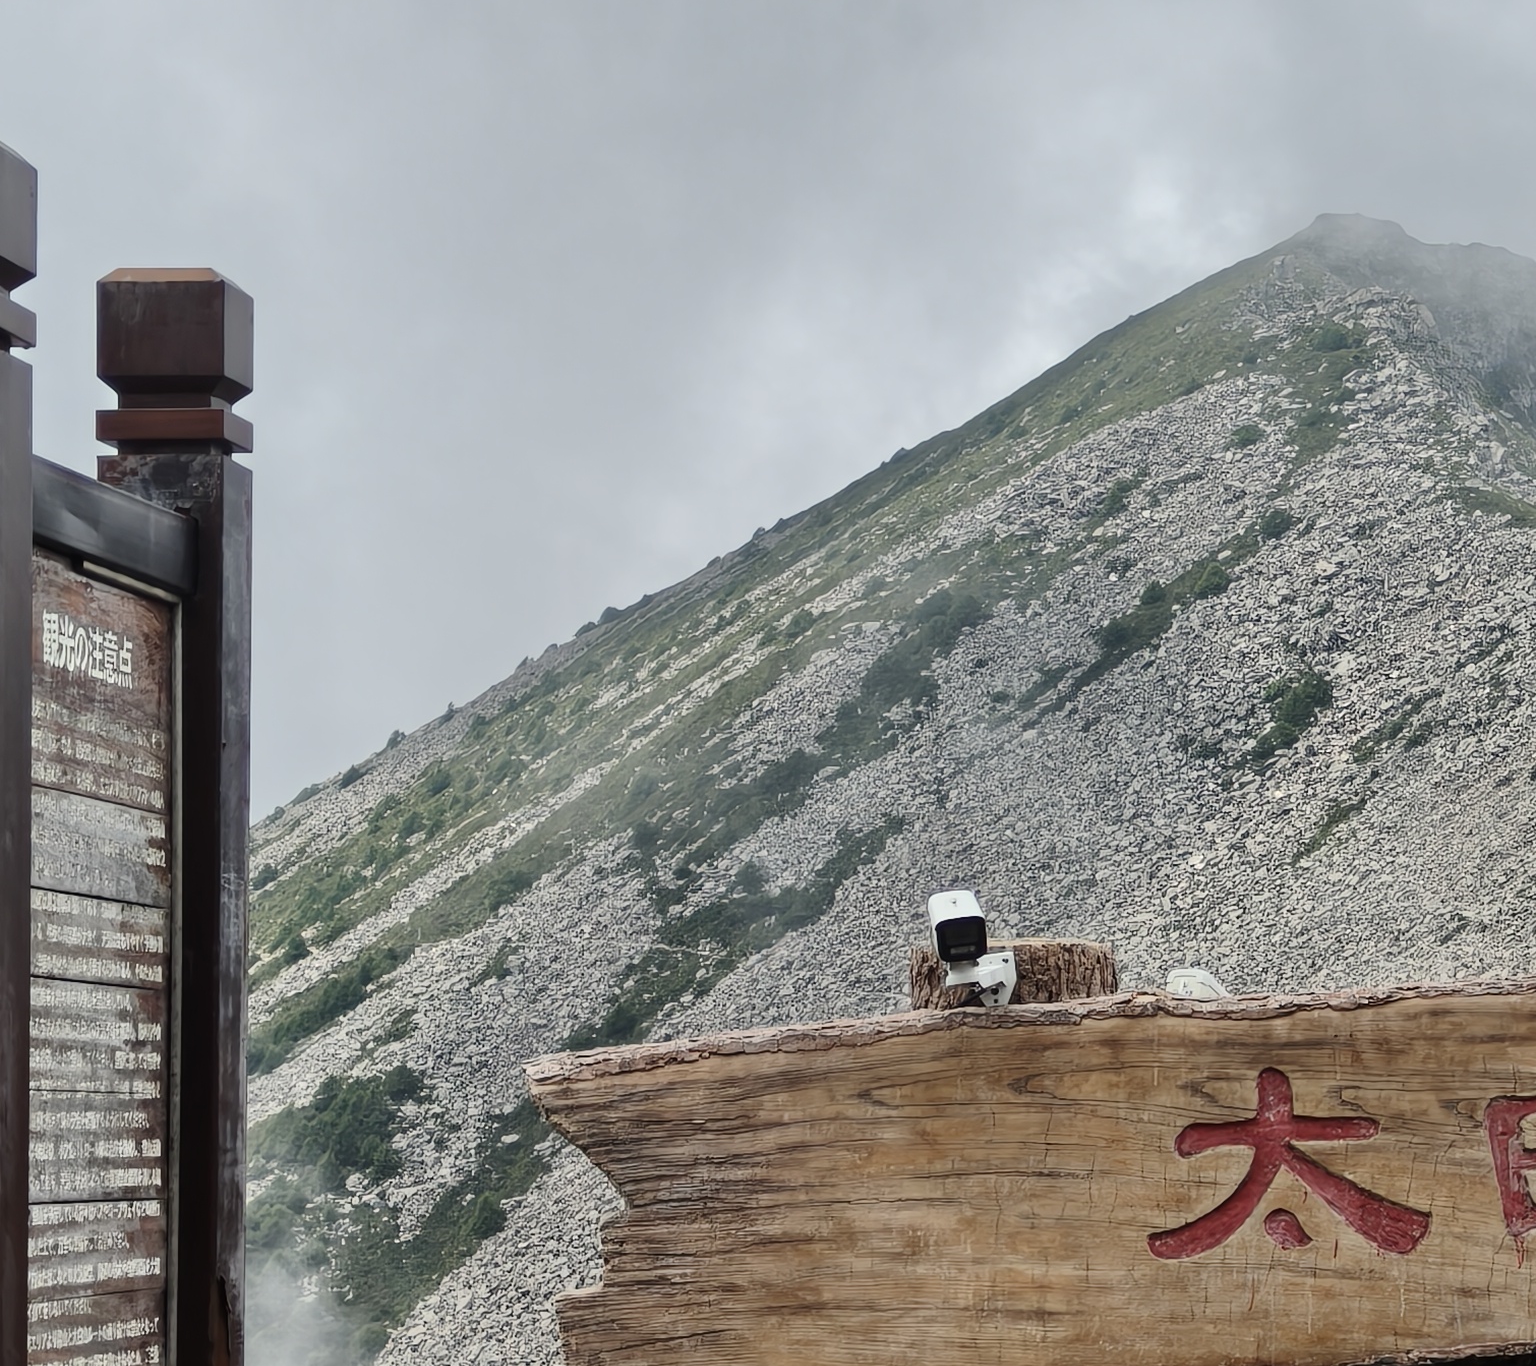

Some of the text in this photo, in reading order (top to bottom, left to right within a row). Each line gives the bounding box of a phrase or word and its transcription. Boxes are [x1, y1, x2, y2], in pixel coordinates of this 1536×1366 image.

[43, 609, 133, 689] 観光の注意点
